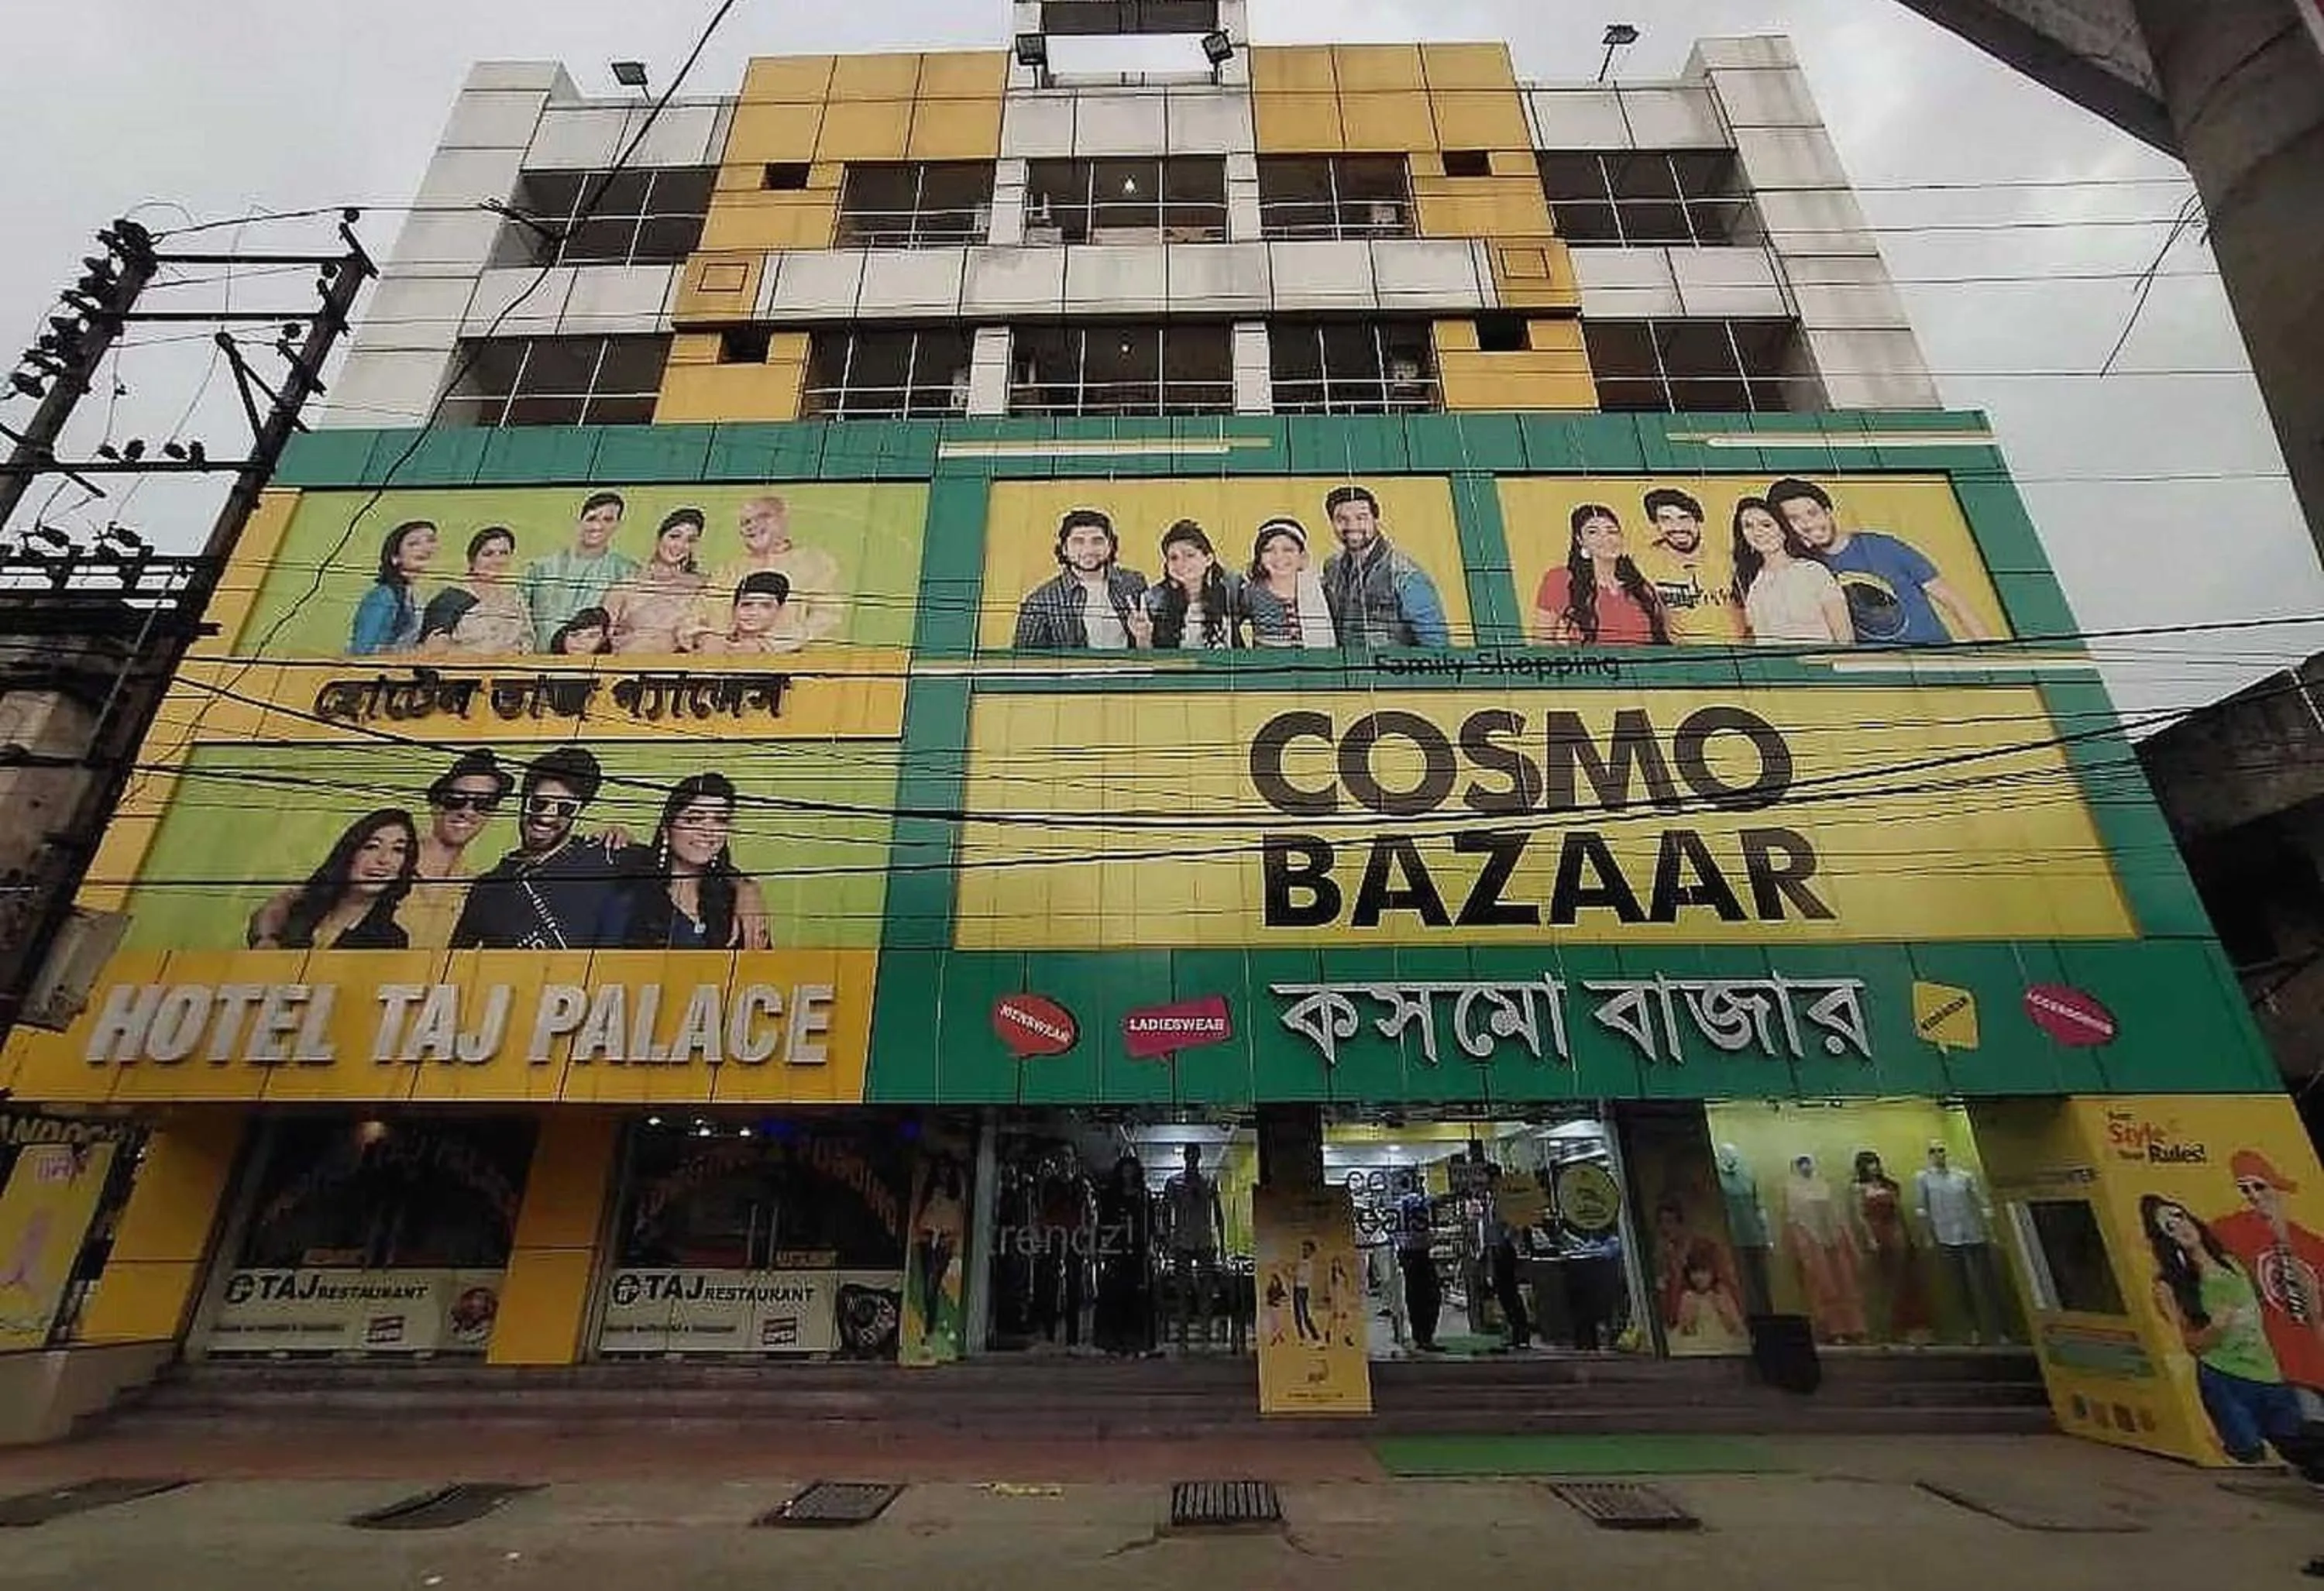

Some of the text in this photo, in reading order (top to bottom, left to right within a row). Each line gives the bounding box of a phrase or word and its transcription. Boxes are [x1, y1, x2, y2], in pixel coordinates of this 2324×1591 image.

[1374, 652, 1621, 683] Family Shopping
[1250, 706, 1793, 815] COSMO
[1262, 827, 1837, 928] BAZAAR
[86, 982, 836, 1067] HOTEL TAJ PALACE
[1129, 1017, 1225, 1031] LADIESWEAR
[1269, 970, 1872, 1065] কসমো বাজার
[258, 1274, 321, 1300] TAJ
[646, 1274, 706, 1301] TAJ
